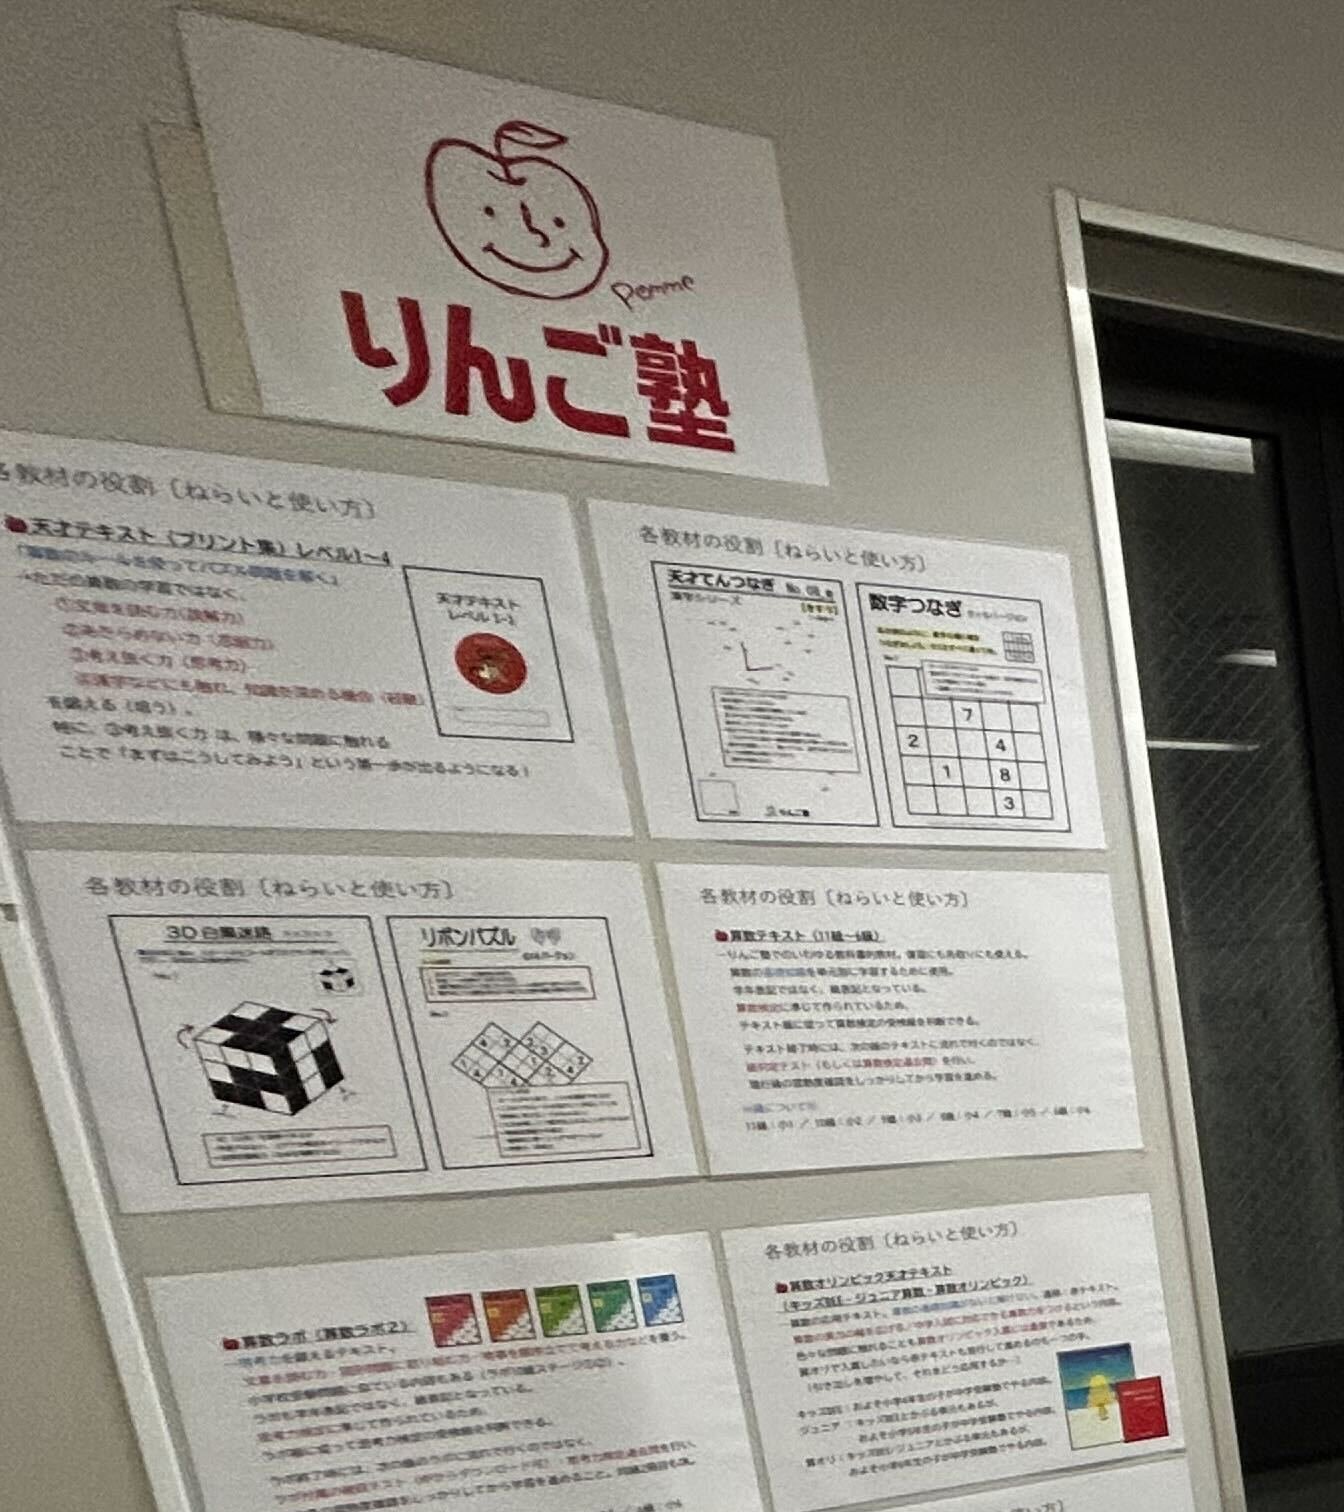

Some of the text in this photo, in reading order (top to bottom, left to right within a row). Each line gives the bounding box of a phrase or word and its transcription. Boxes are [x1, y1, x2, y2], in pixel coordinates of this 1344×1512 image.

[341, 290, 736, 453] りんご塾
[667, 567, 775, 593] 天才てんつなぎ
[869, 591, 964, 619] 数字つなぎ
[962, 707, 973, 722] 7
[908, 733, 920, 749] 2
[995, 738, 1007, 753] 4
[942, 764, 951, 781] 1
[1000, 766, 1012, 782] 8
[1003, 796, 1015, 811] 3
[420, 925, 517, 948] リボンパズル
